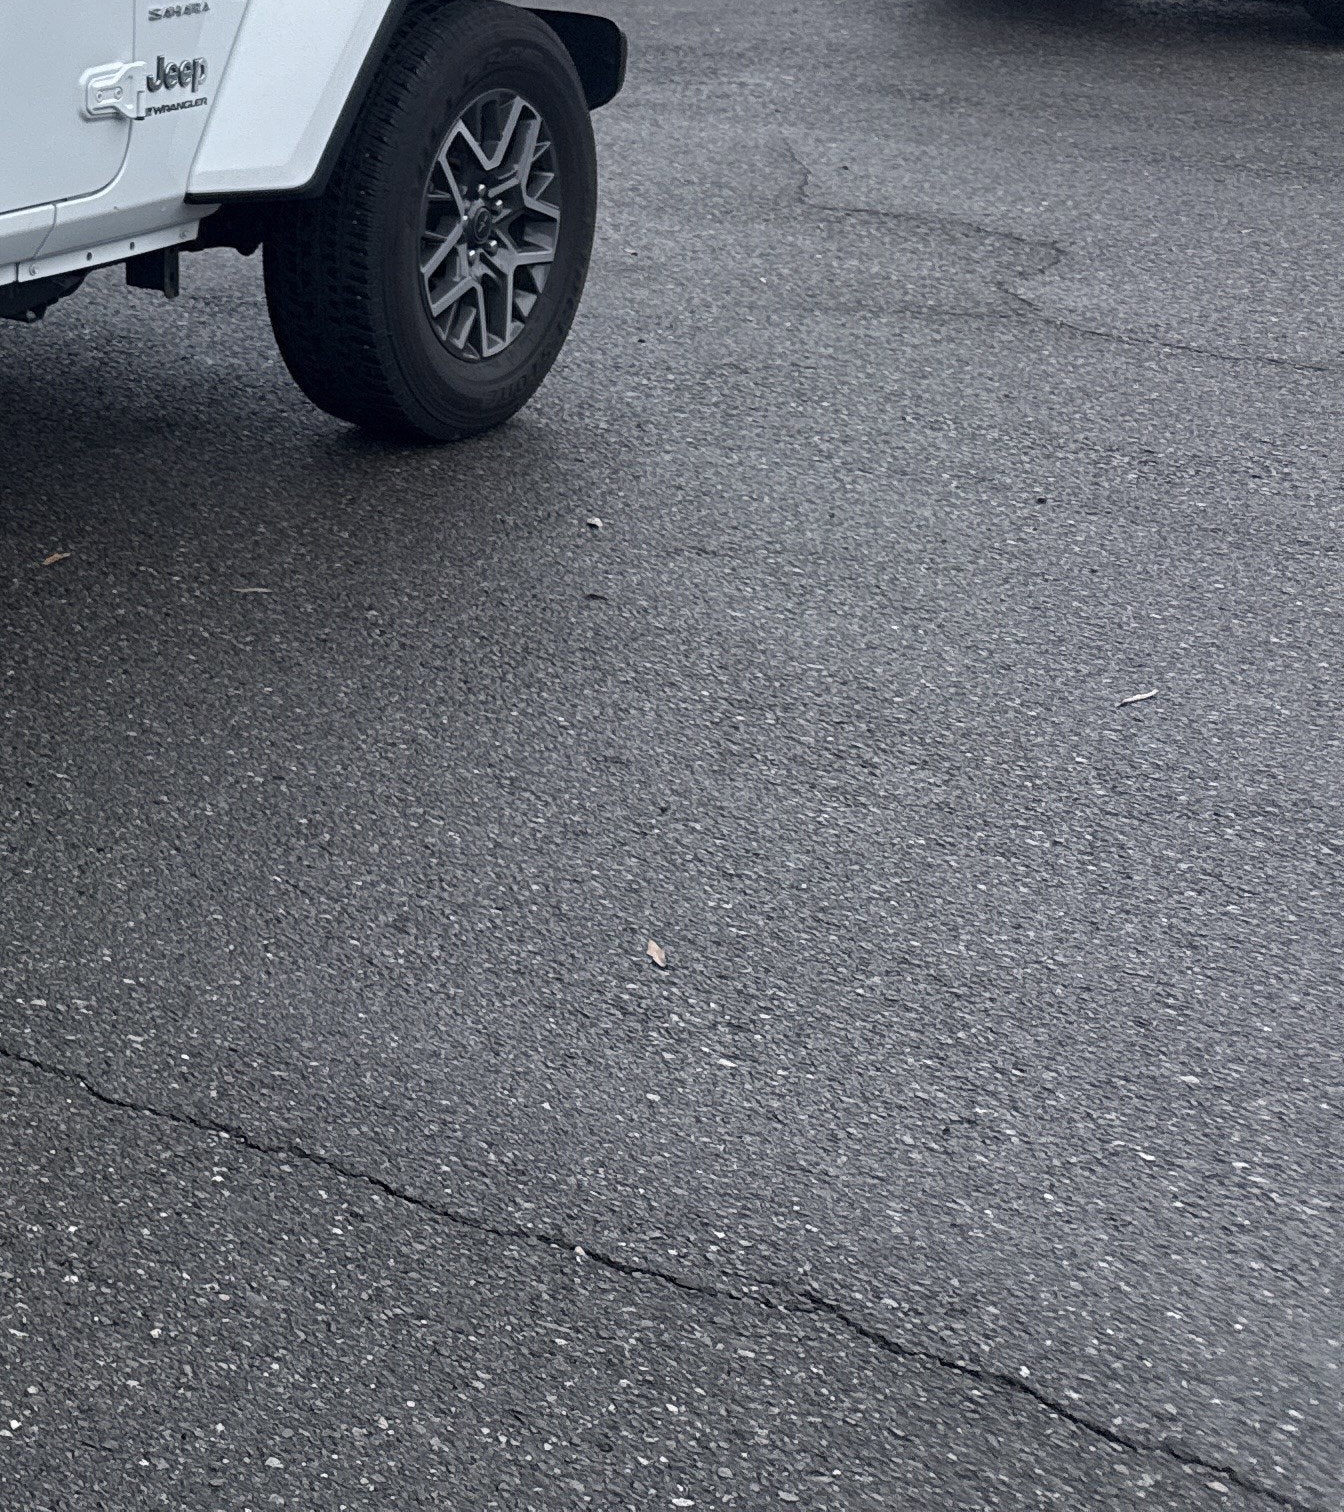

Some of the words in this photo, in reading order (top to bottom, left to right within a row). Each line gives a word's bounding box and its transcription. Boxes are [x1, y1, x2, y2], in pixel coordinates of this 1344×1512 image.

[148, 1, 210, 21] SAHARA
[146, 55, 208, 93] Jeep
[153, 97, 208, 116] WRANGLER
